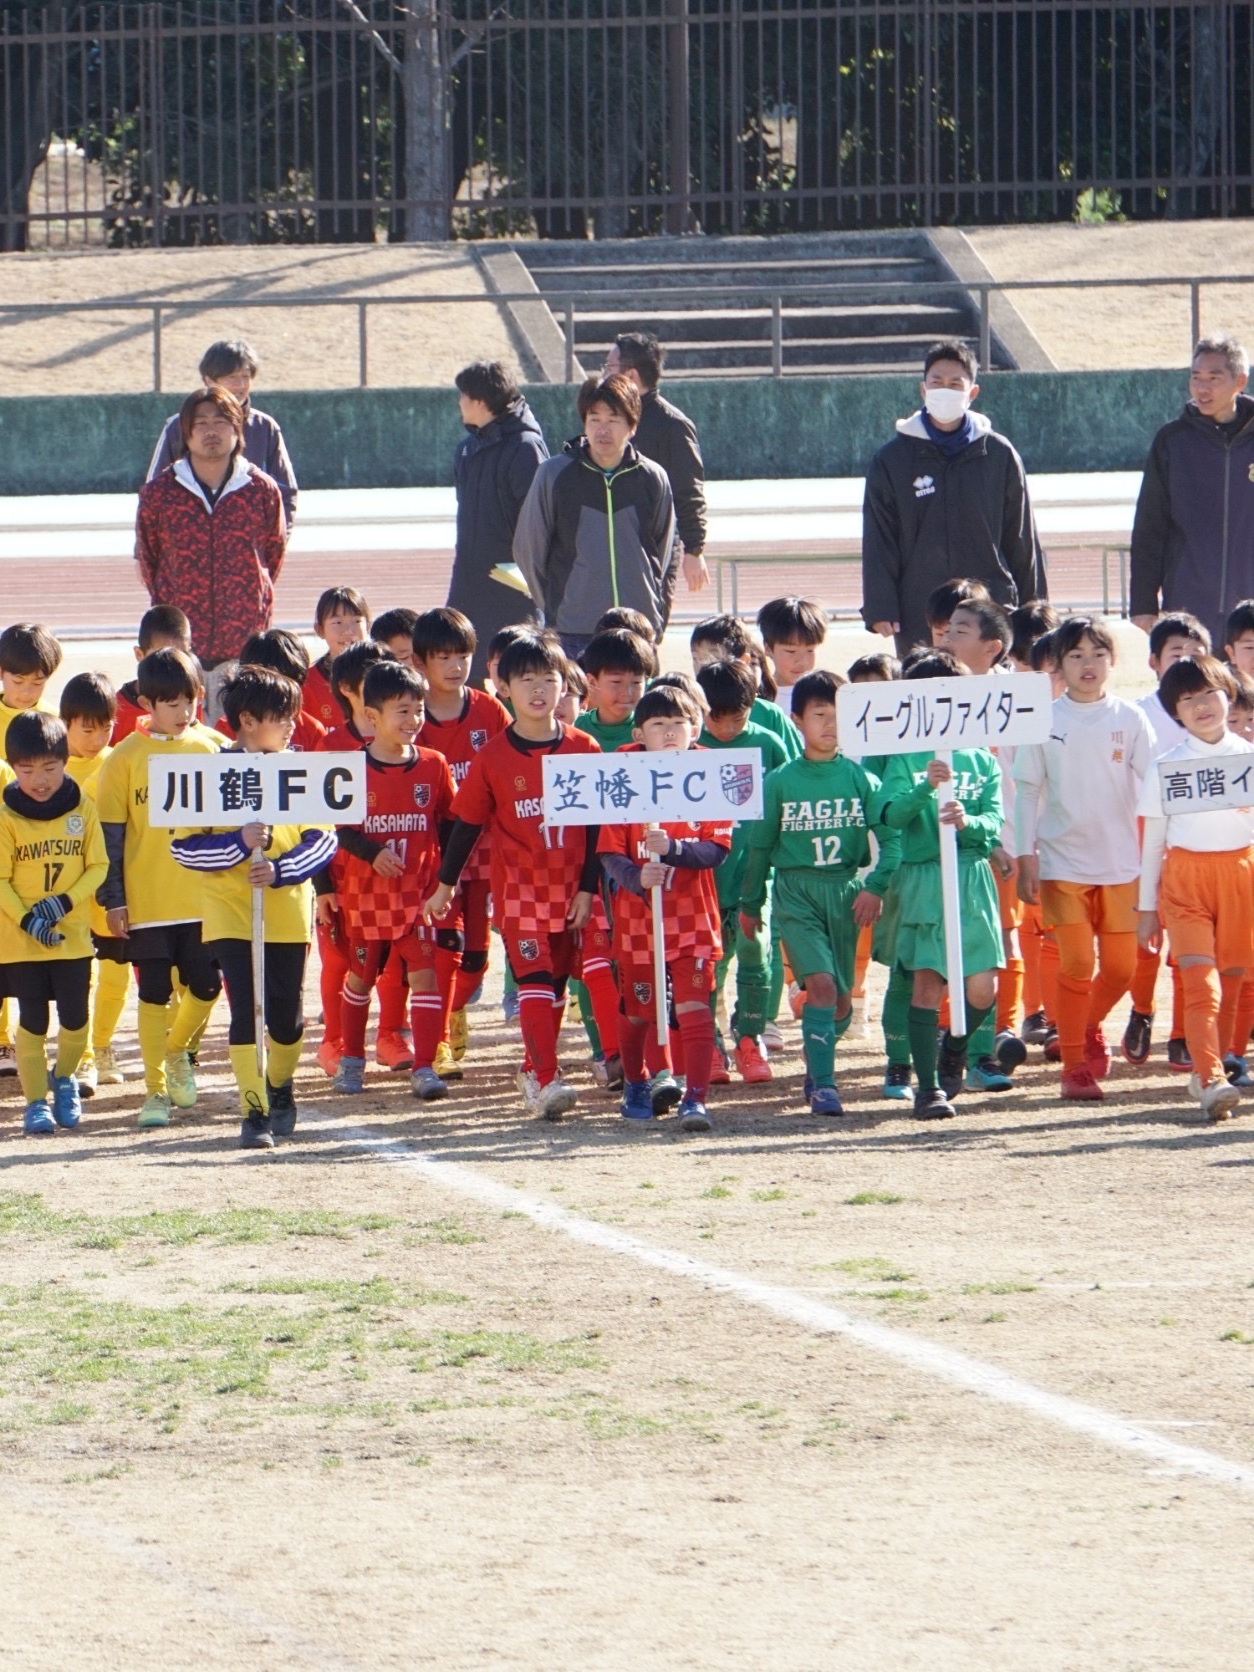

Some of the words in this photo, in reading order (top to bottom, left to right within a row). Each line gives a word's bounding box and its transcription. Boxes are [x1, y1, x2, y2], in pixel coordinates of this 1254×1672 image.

[856, 691, 1034, 743] イーグルファイター
[163, 767, 354, 813] 川鶴FC
[552, 767, 707, 812] 笠幡FC
[1163, 766, 1252, 802] 高階イ
[363, 813, 428, 834] KASAHATA
[781, 798, 865, 822] EAGLE
[781, 818, 843, 832] FIGHTER
[811, 835, 842, 866] 12
[43, 862, 65, 892] 17
